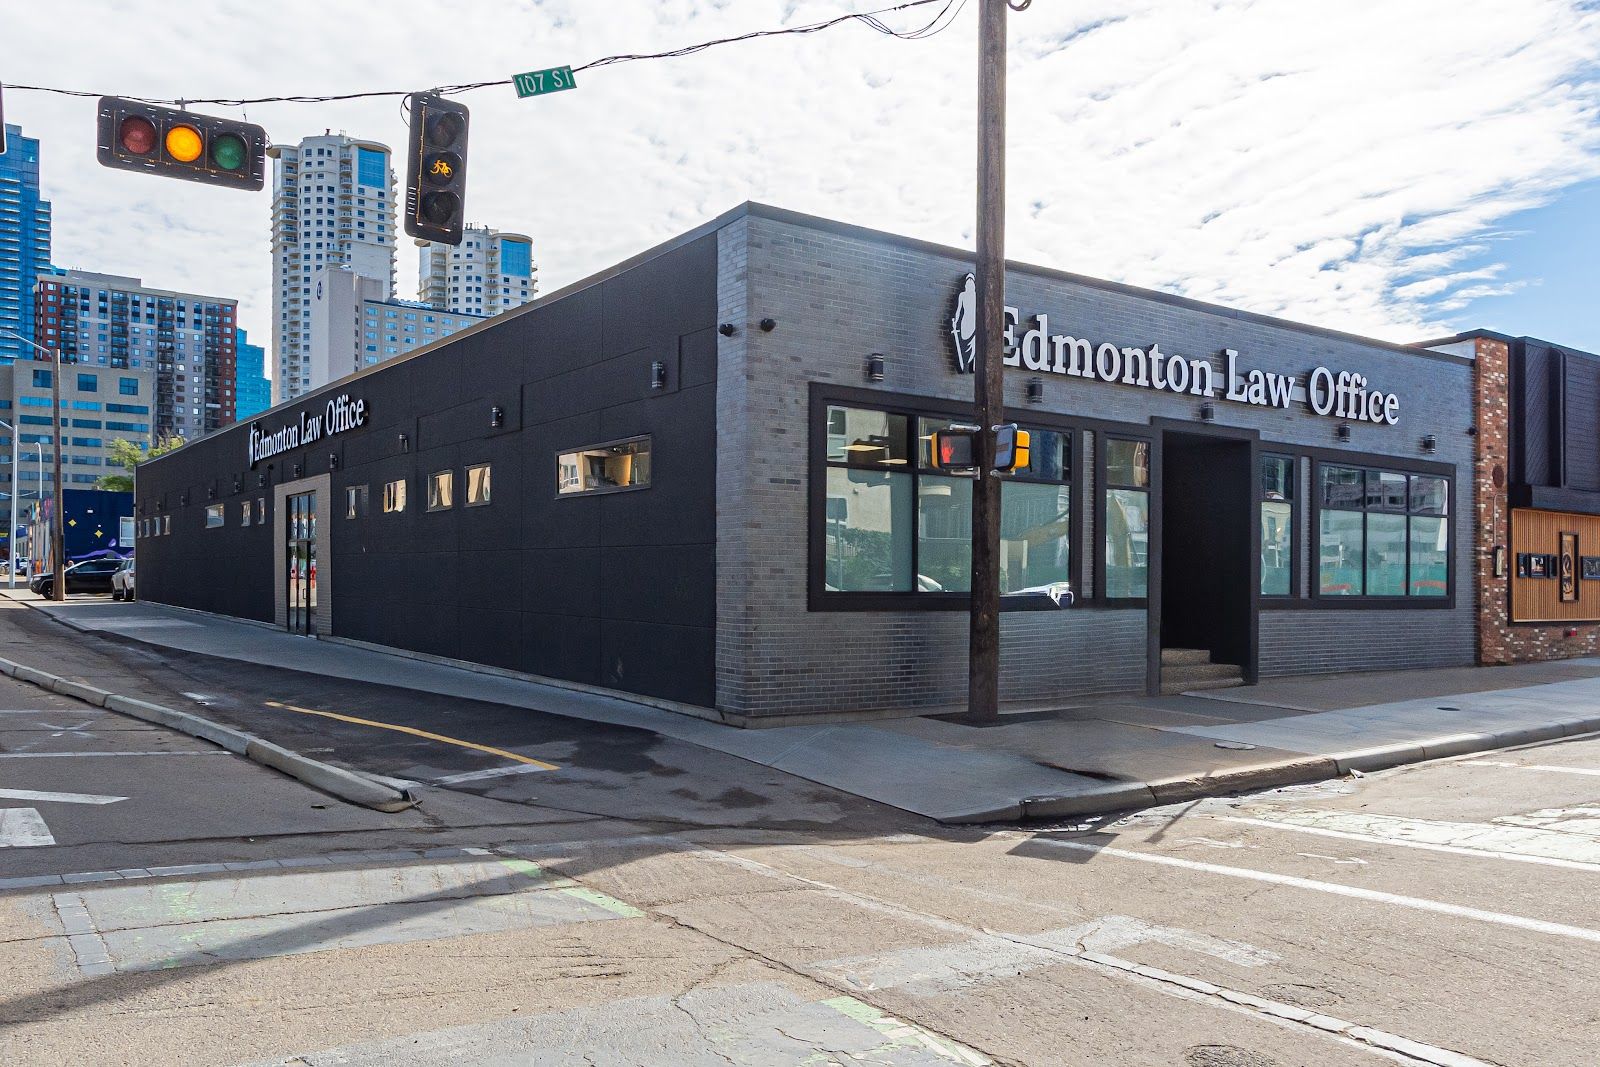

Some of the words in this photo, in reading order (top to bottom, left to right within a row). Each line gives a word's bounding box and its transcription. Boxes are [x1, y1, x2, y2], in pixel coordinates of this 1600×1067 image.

[518, 73, 544, 94] 107
[552, 68, 571, 88] ST
[1226, 349, 1296, 409] Law
[1310, 366, 1400, 426] Office
[254, 424, 299, 462] Edmonton
[301, 411, 323, 445] Law
[325, 394, 364, 436] Office
